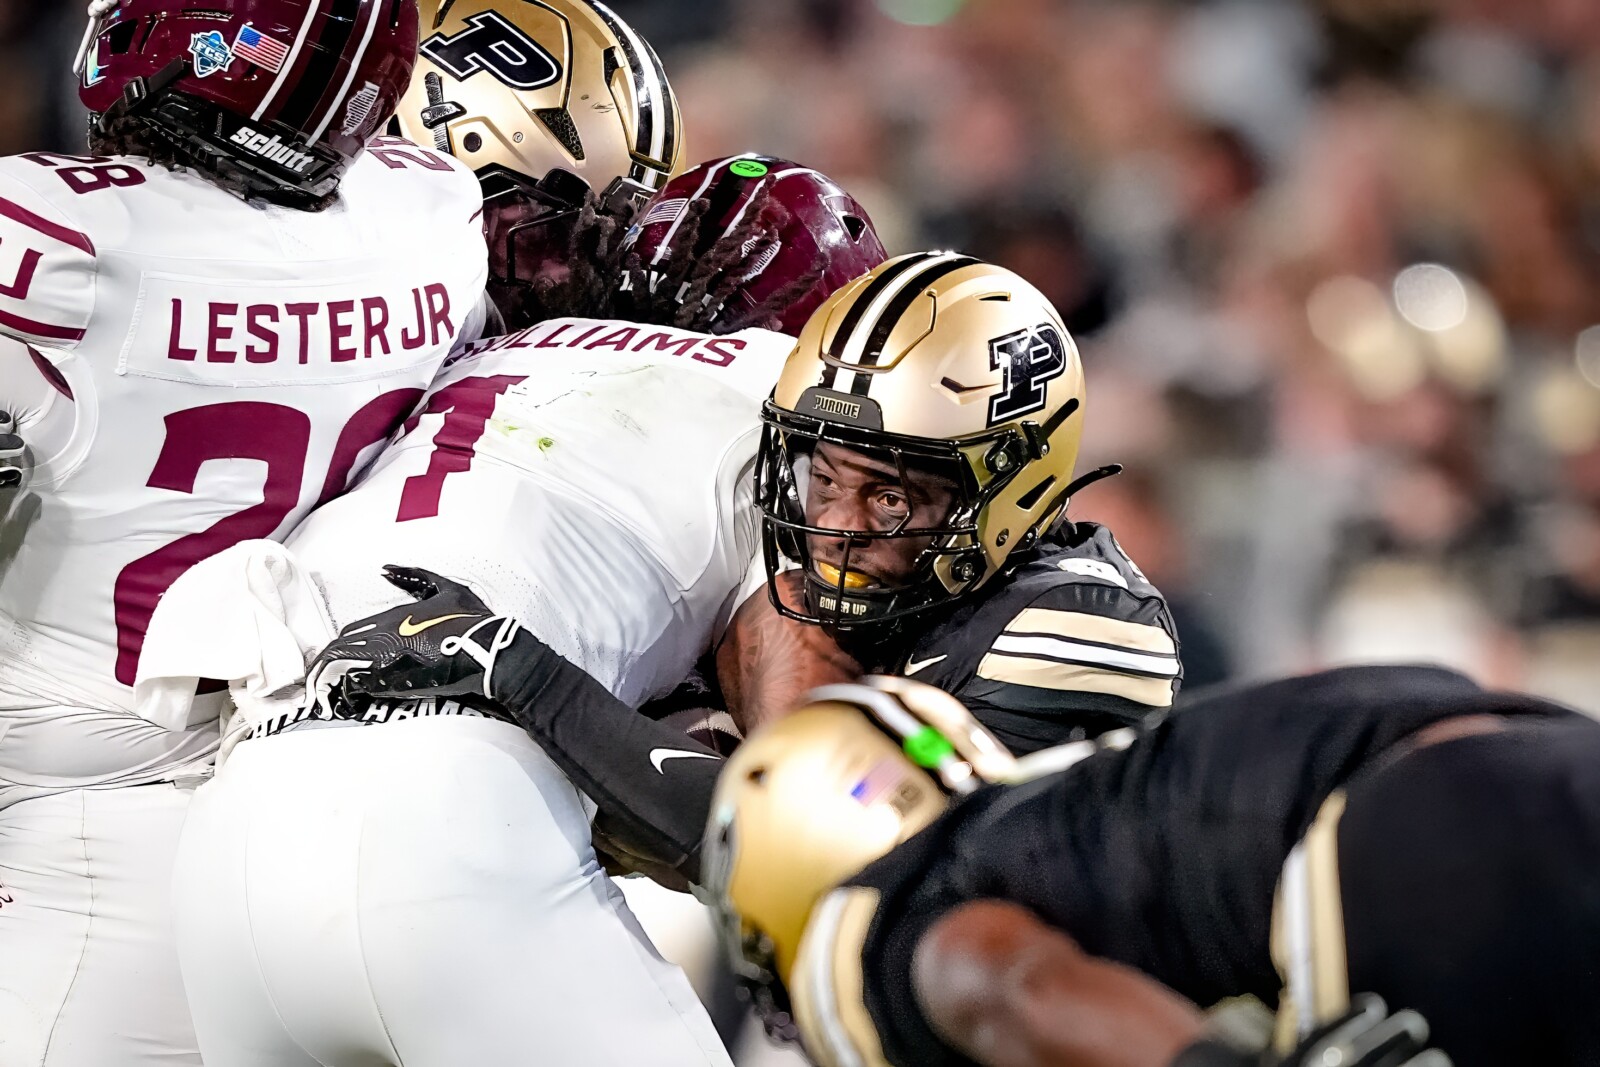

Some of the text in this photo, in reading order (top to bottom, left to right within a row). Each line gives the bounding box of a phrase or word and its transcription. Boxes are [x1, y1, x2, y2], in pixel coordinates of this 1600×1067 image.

[194, 40, 227, 63] FCS
[419, 9, 563, 91] P
[229, 126, 315, 173] schutt
[168, 282, 455, 365] LESTER JR
[986, 322, 1067, 429] P
[814, 395, 861, 419] PURDUE
[852, 603, 867, 616] UP
